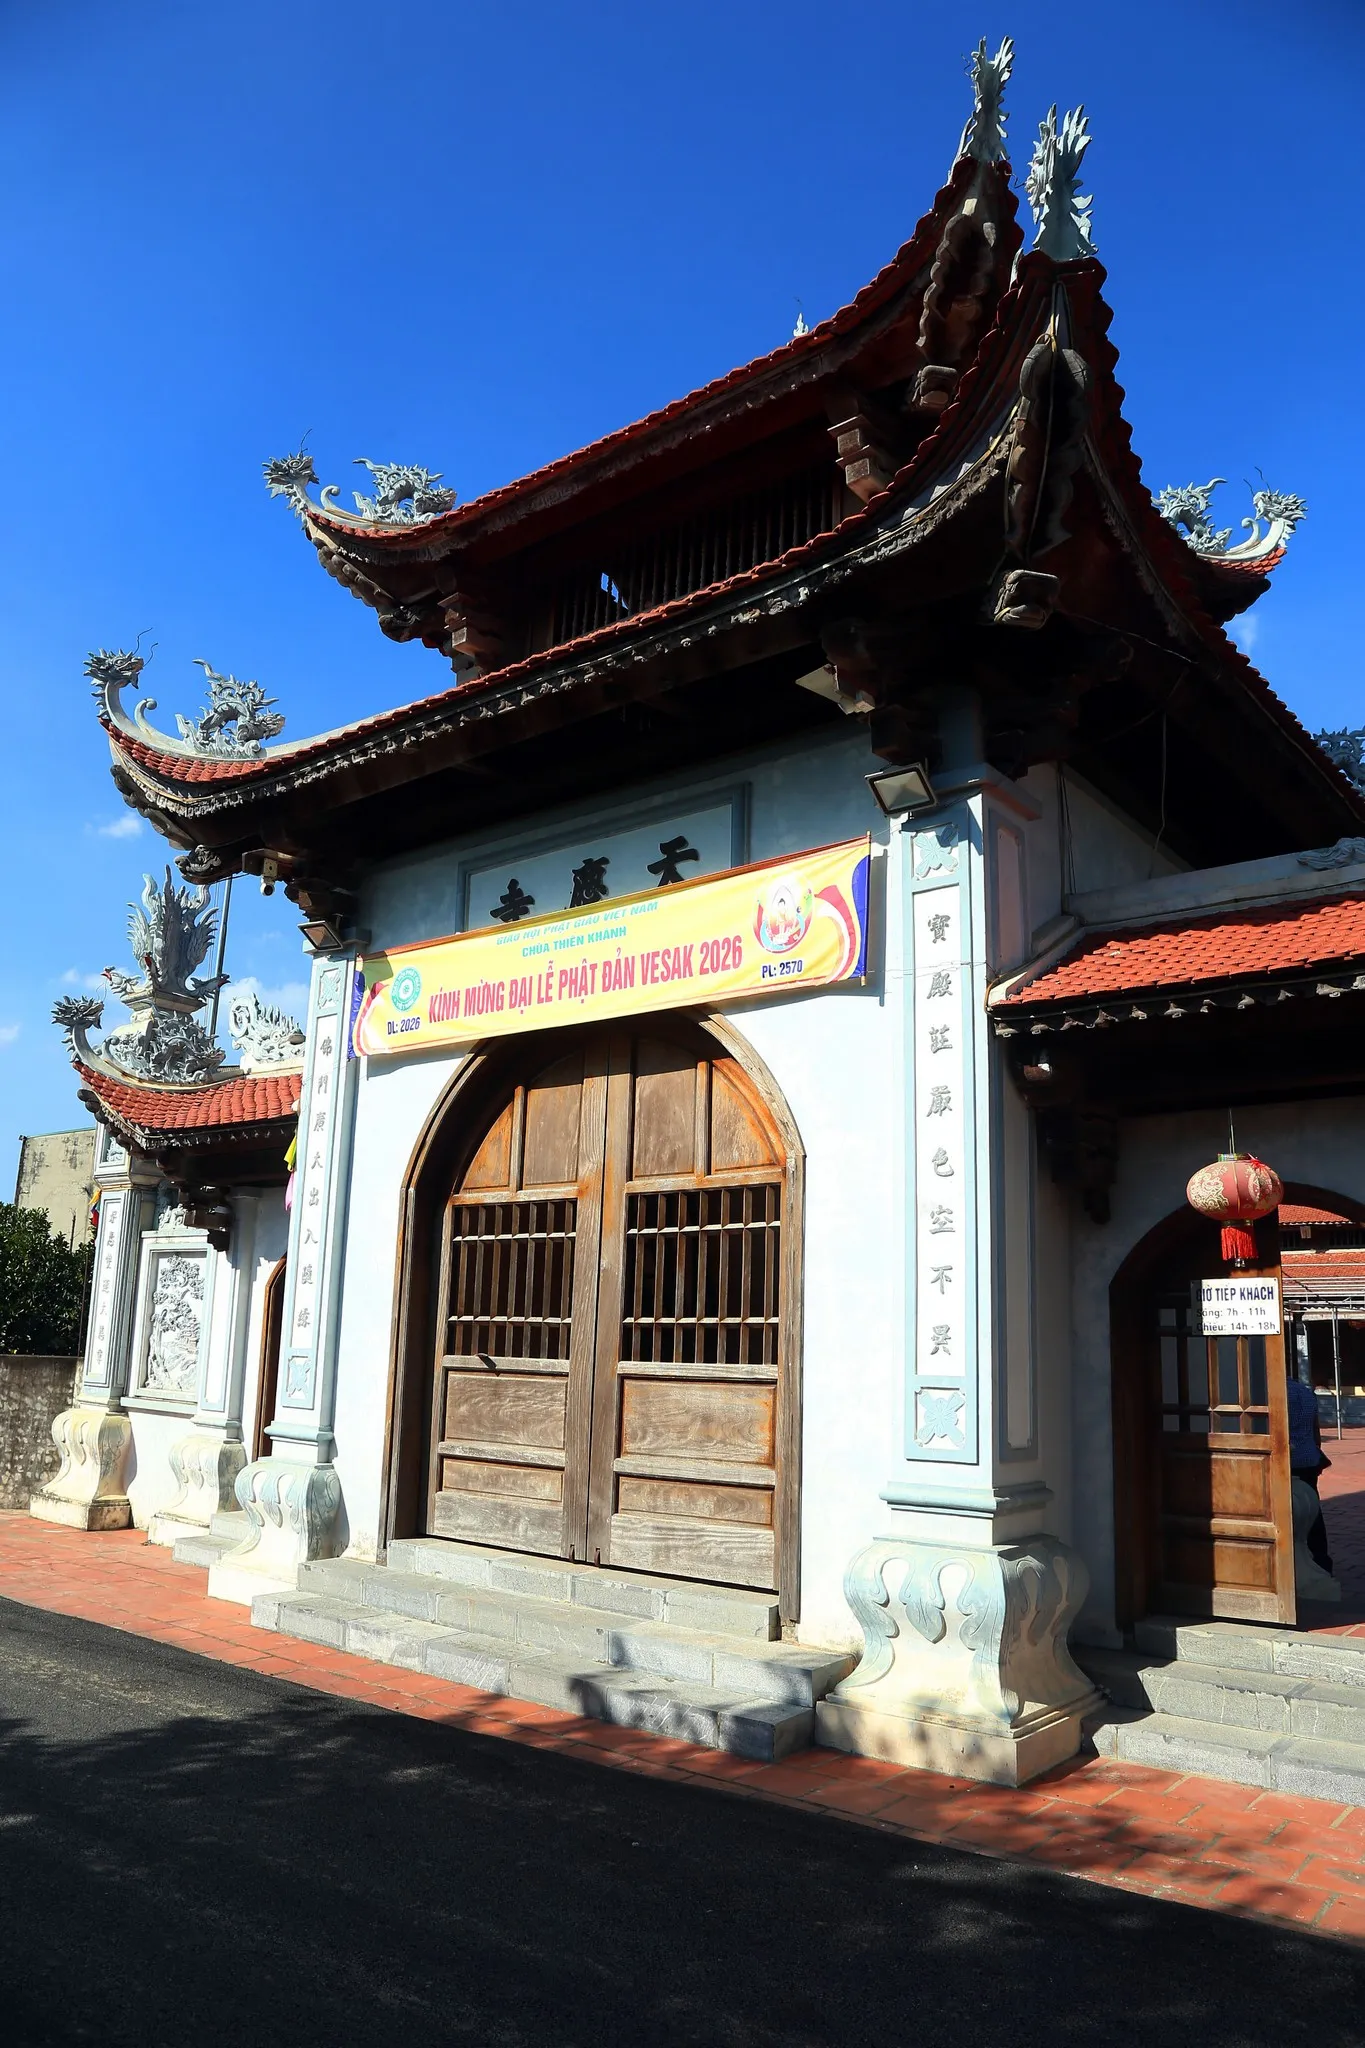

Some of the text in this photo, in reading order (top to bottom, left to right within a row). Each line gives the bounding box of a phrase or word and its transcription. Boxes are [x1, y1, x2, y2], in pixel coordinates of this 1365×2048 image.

[630, 901, 659, 916] NAM
[522, 926, 627, 957] CHÙA THIÊN KHÁNH
[761, 959, 803, 978] PL: 2570
[428, 987, 461, 1023] KÍNH
[464, 979, 505, 1017] MỪNG
[508, 976, 533, 1015] ĐẠI
[537, 960, 554, 1004] LỄ
[558, 958, 598, 1004] PHẬT
[601, 947, 635, 992] ĐẢN
[640, 943, 695, 986] VESAK
[699, 935, 743, 975] 2026
[387, 1016, 421, 1035] DL: 2026
[1215, 1282, 1237, 1301] TIẾP
[1239, 1284, 1275, 1301] KHÁCH
[1226, 1307, 1239, 1317] 7h
[1248, 1307, 1267, 1316] 11h
[1230, 1322, 1248, 1331] 14h
[1258, 1321, 1276, 1331] 18h
